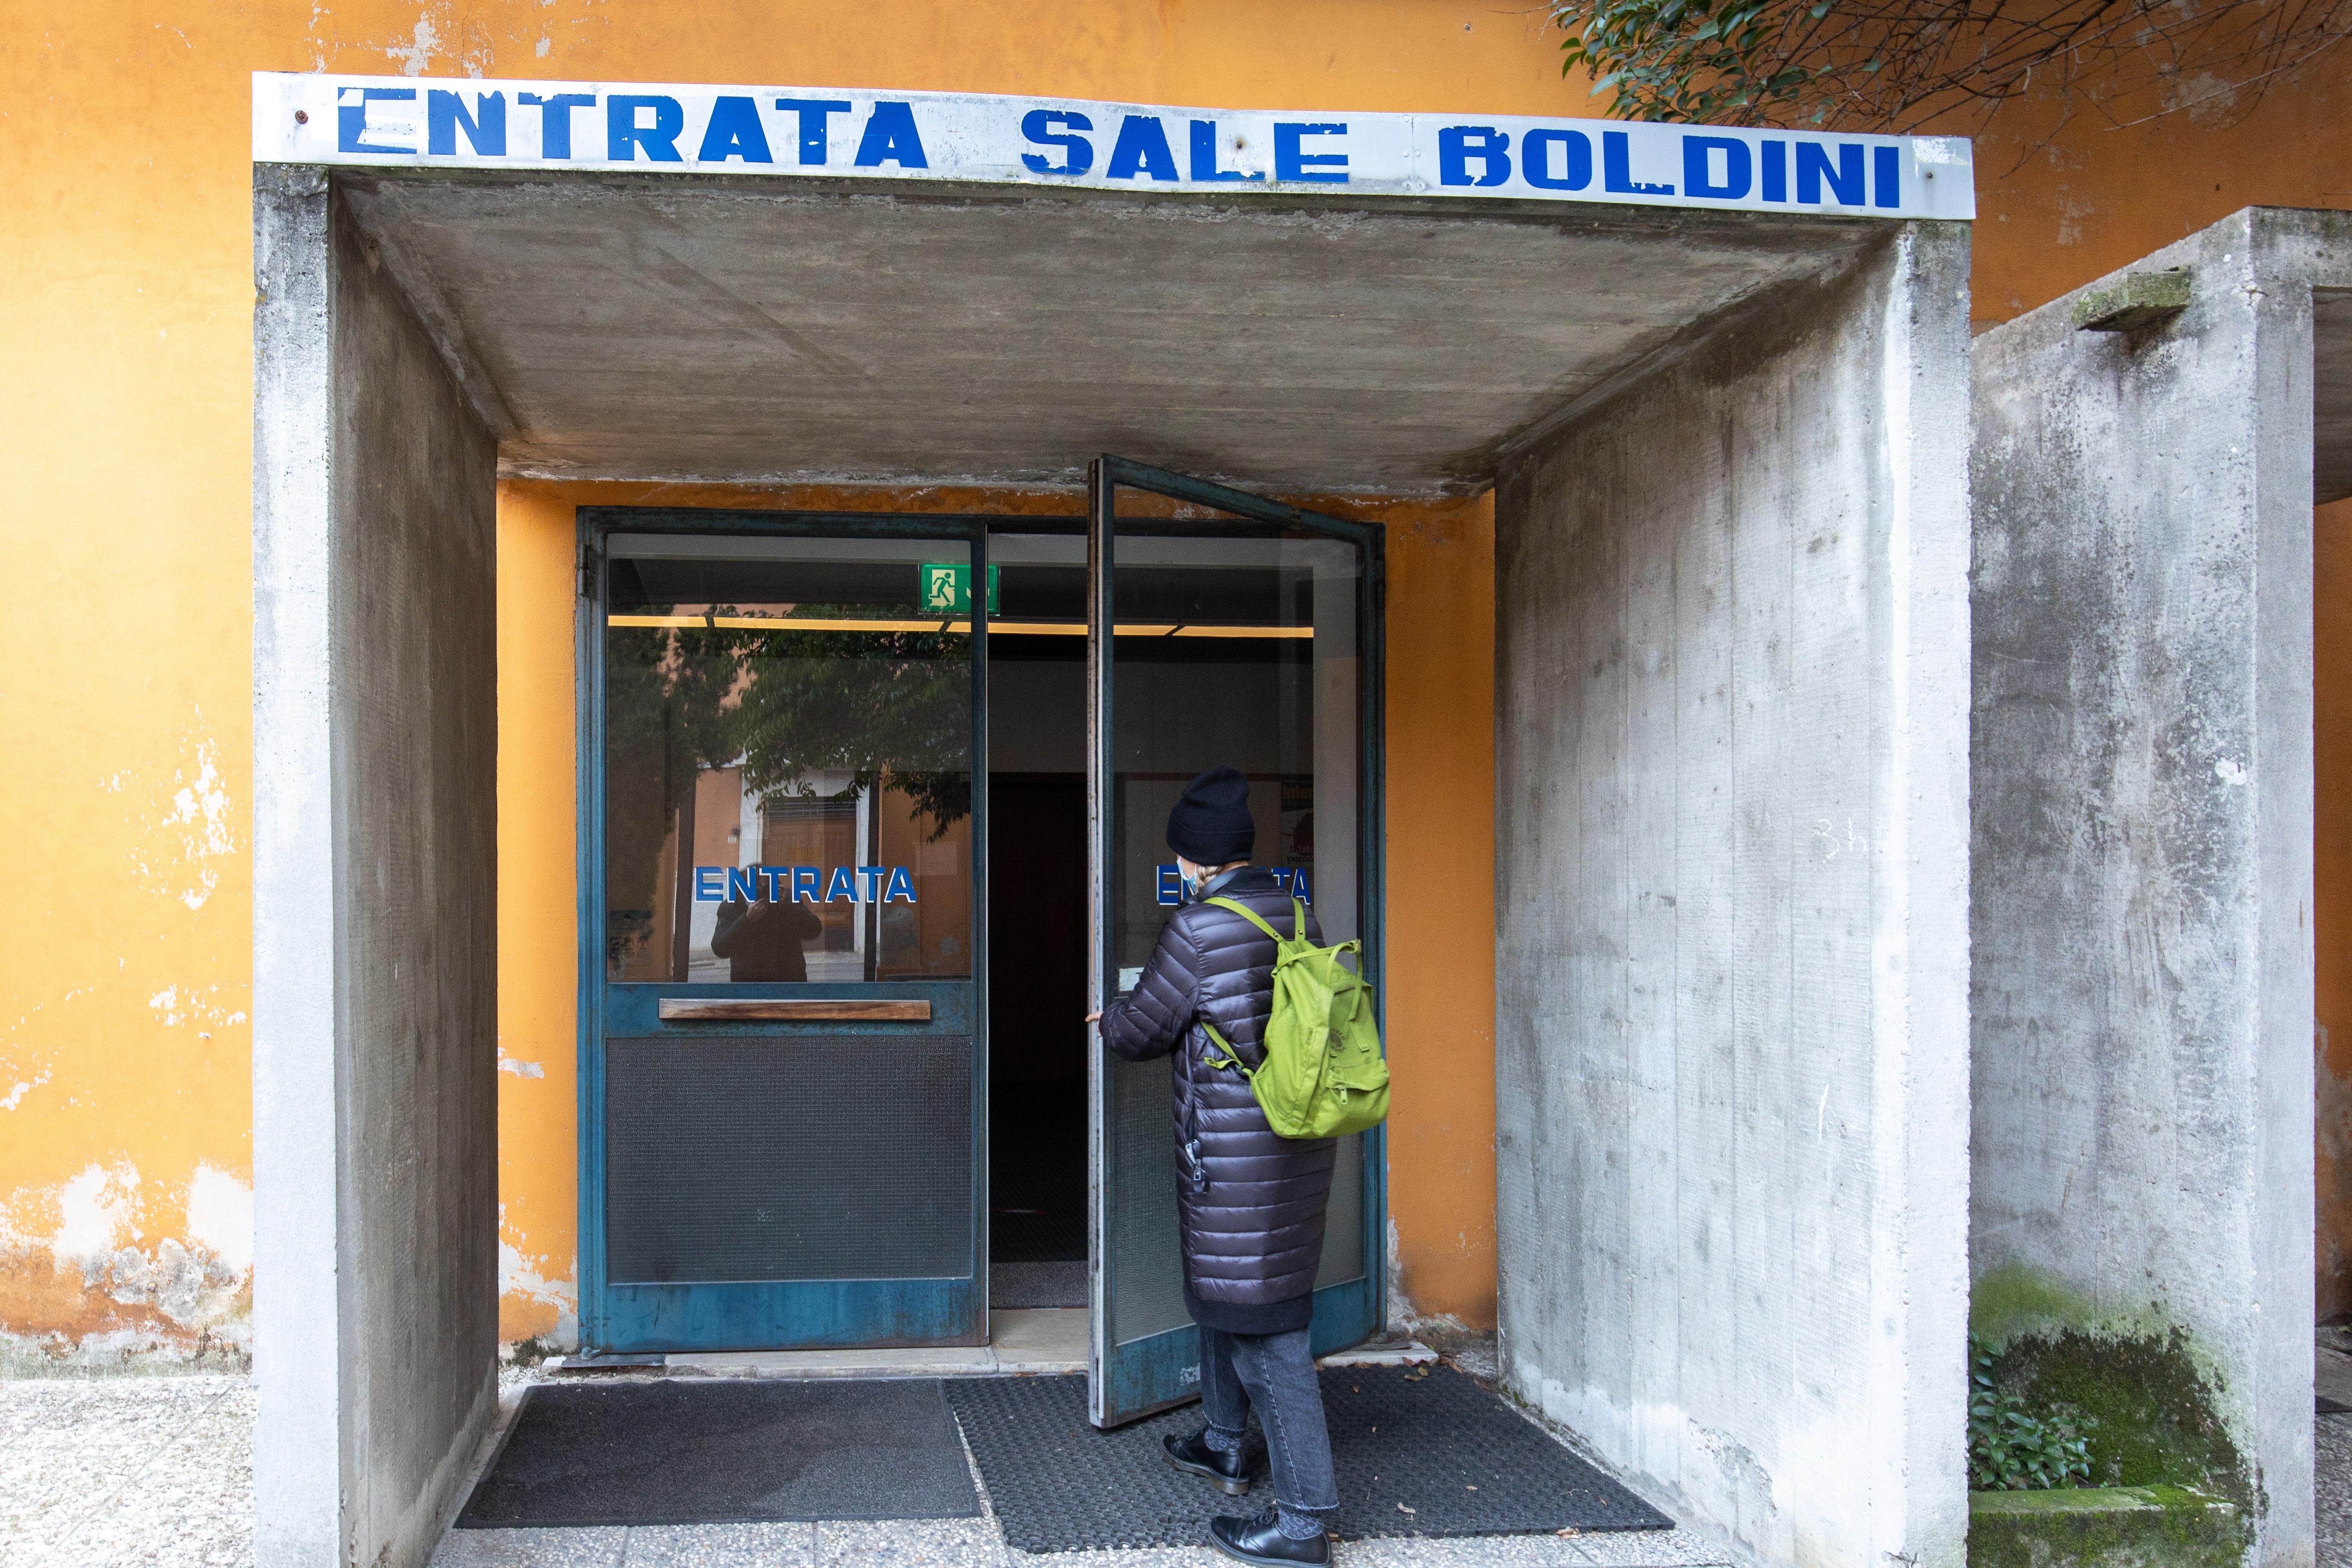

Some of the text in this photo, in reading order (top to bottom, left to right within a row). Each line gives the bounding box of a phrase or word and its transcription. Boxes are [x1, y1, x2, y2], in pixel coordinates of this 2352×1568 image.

[337, 87, 1900, 208] ENTRATA SALE BOLDINI
[694, 866, 917, 903] ENTRATA
